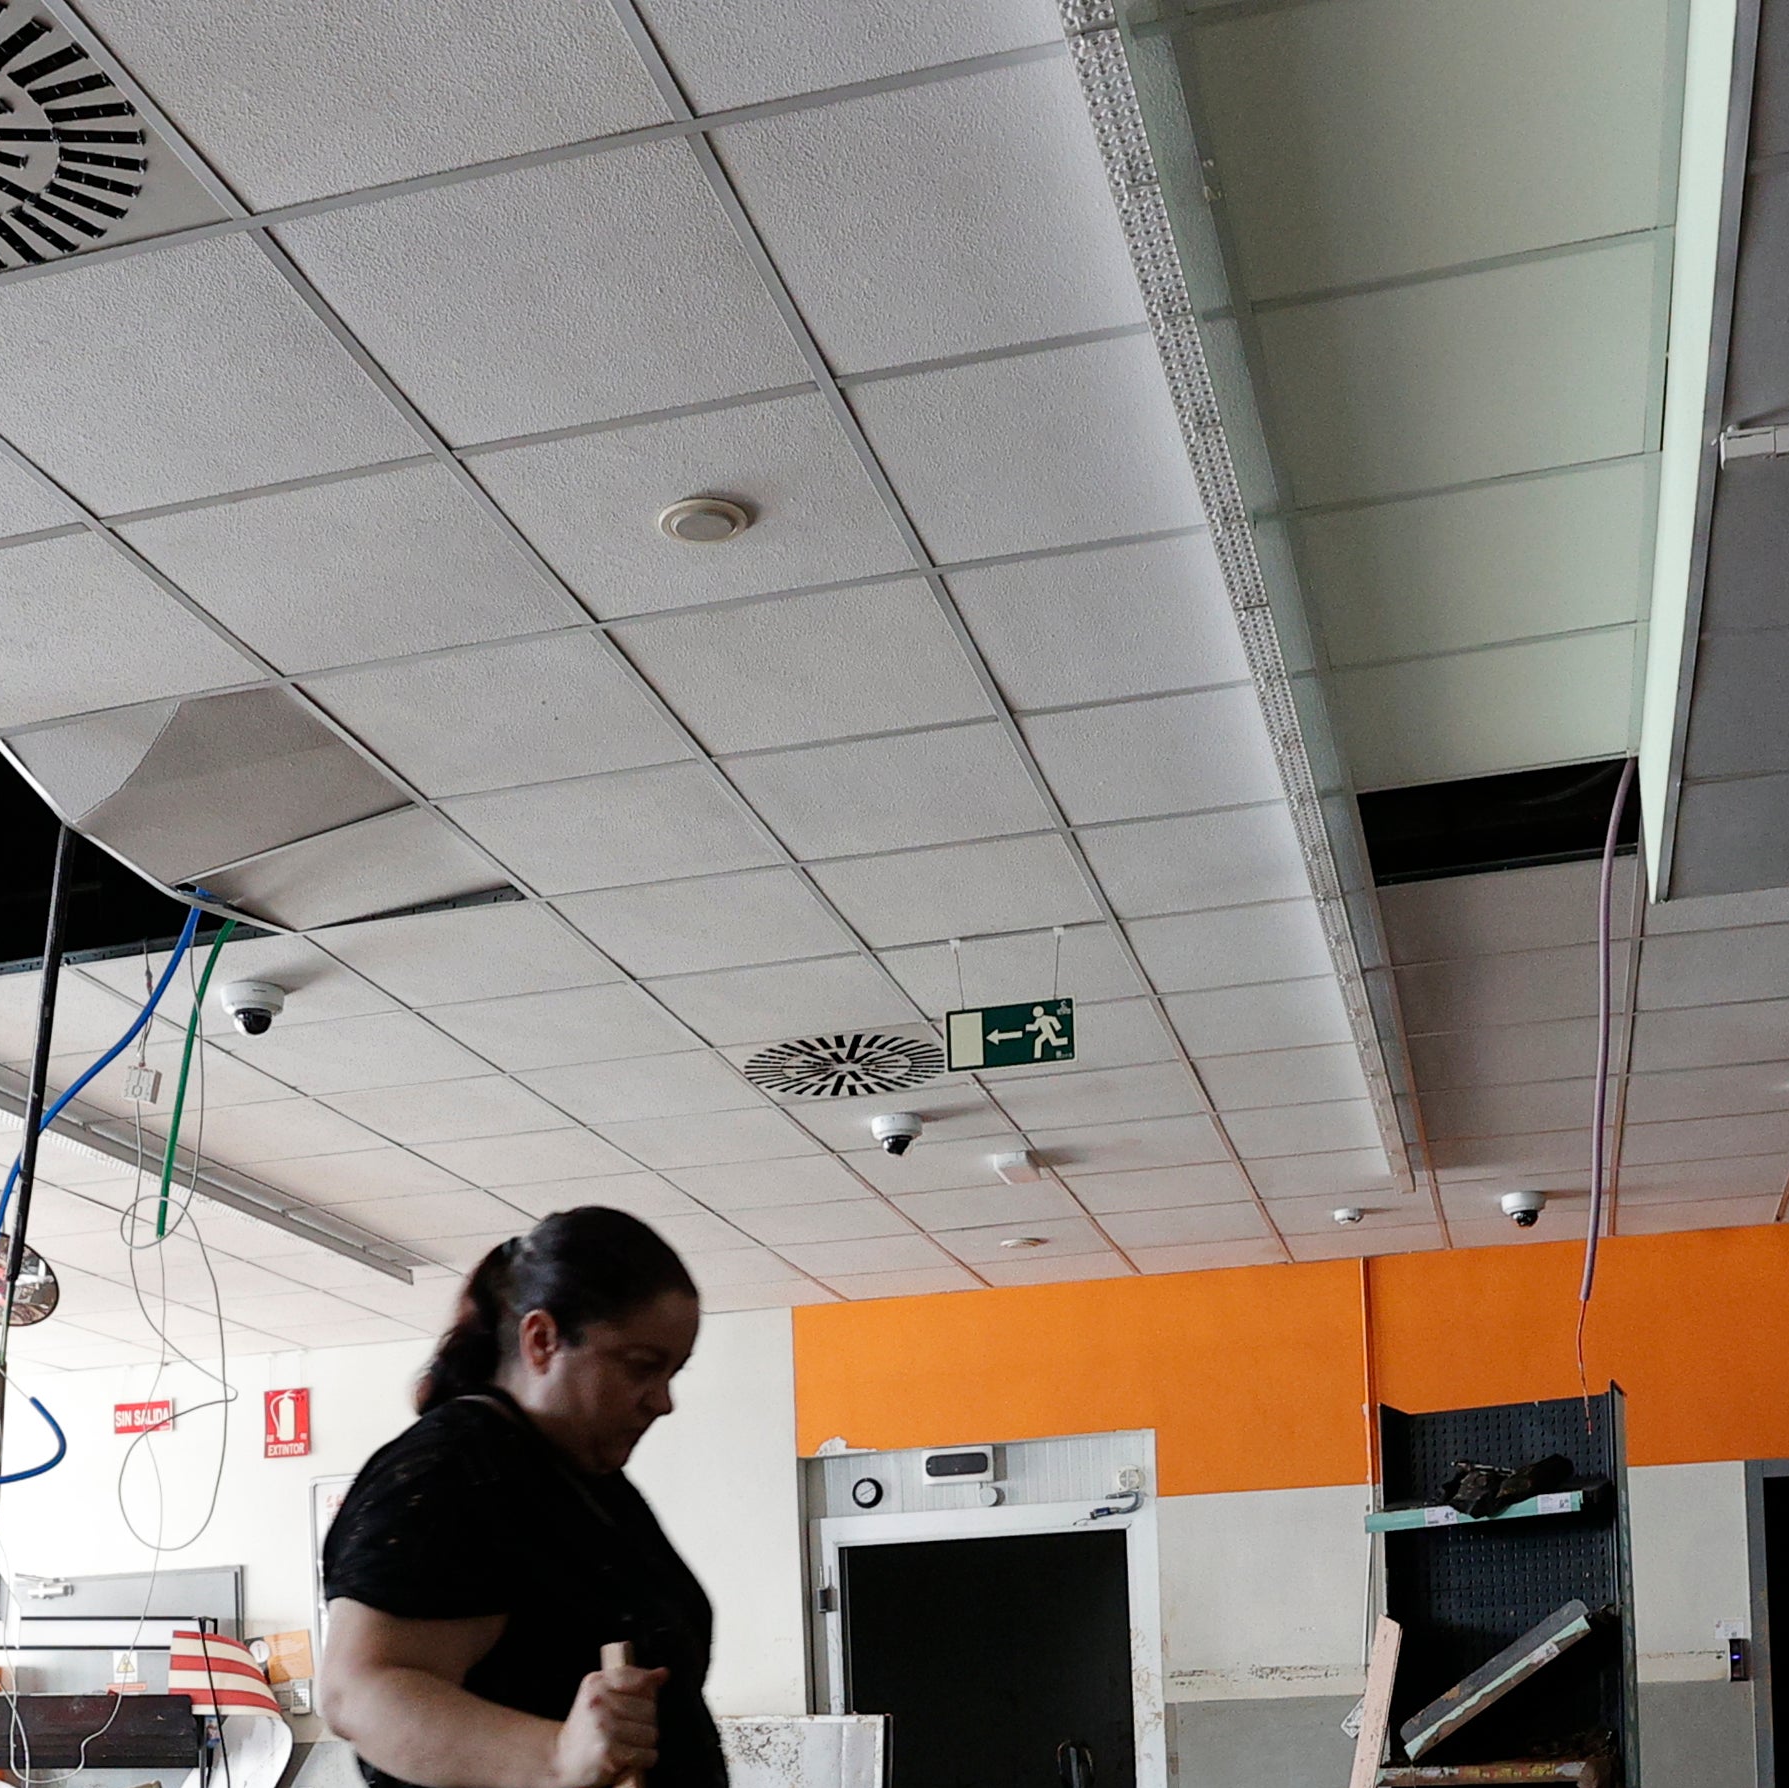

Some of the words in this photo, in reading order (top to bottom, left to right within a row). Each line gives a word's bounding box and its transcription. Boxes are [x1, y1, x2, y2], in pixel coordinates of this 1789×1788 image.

[115, 1411, 133, 1428] SIN
[134, 1406, 170, 1426] SALIDA
[267, 1442, 305, 1457] EXTINTOR
